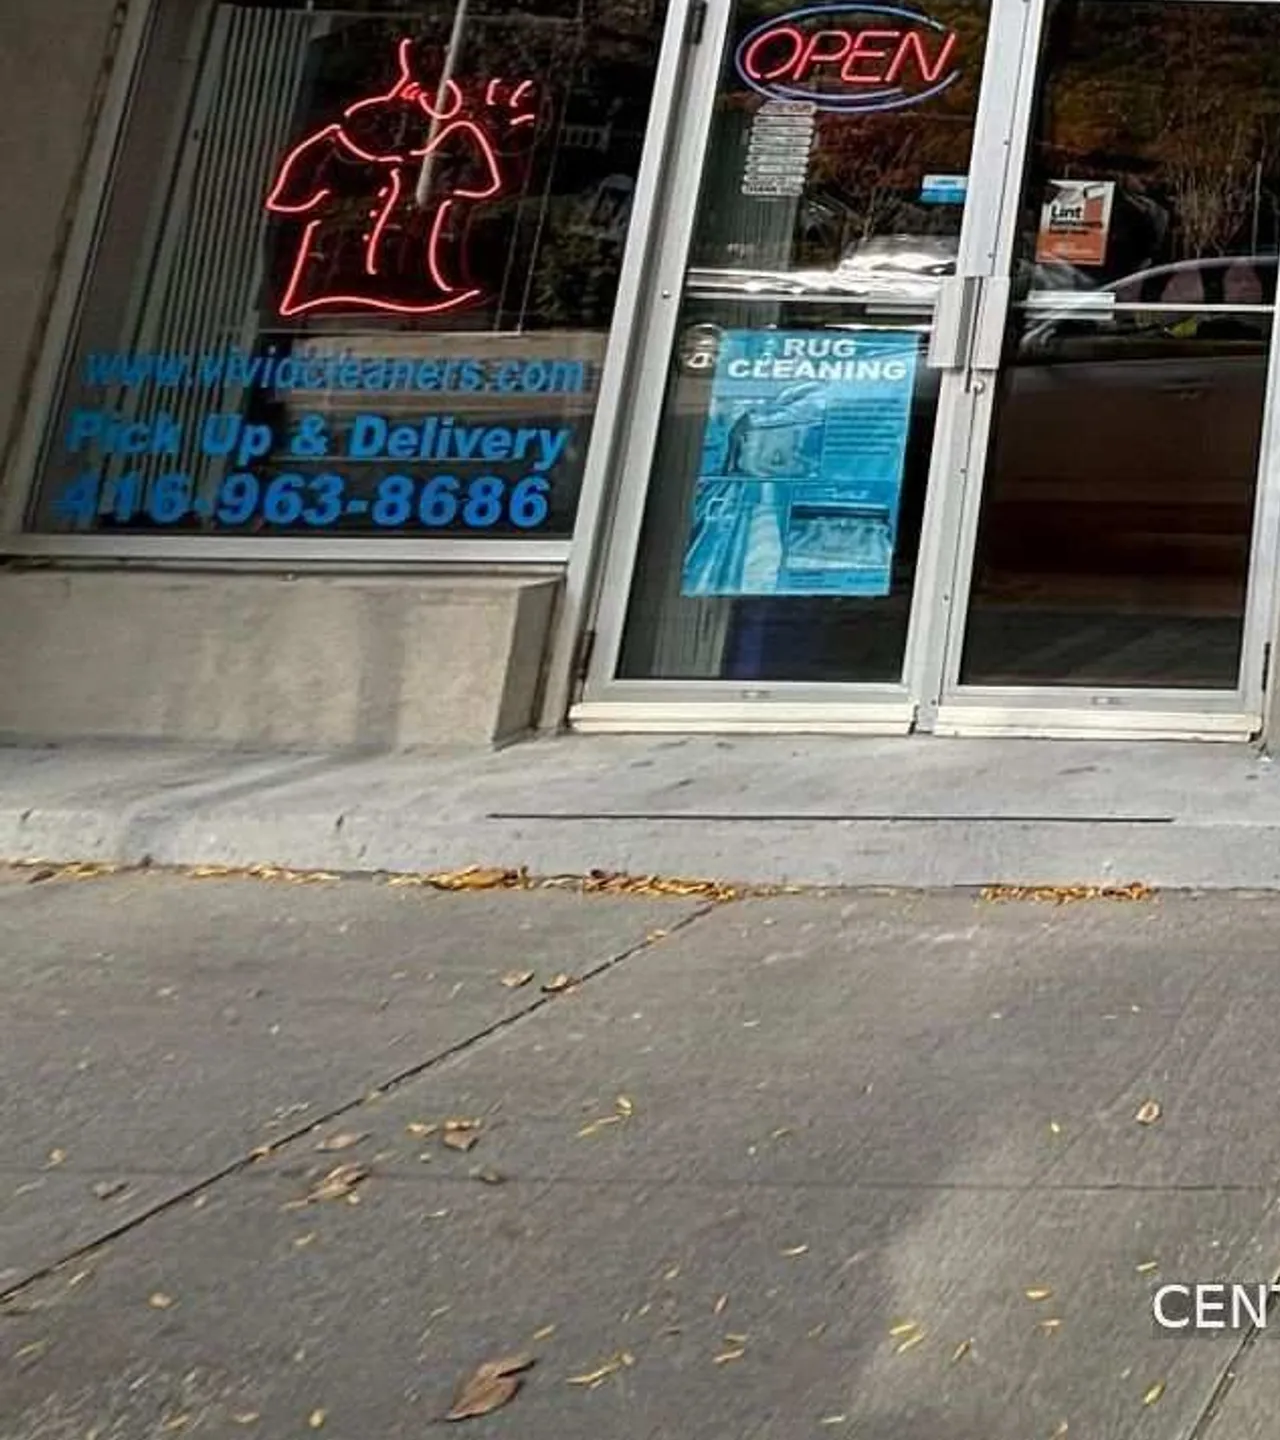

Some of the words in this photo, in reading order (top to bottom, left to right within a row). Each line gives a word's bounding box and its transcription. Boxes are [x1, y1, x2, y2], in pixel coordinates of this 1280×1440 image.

[741, 26, 956, 83] OPEN
[727, 359, 908, 381] CLEANING
[784, 337, 857, 358] RUG
[65, 409, 183, 455] Pick
[202, 412, 272, 467] Up
[291, 413, 328, 456] &
[350, 413, 571, 471] Delivery
[49, 468, 551, 530] 416-963-8686
